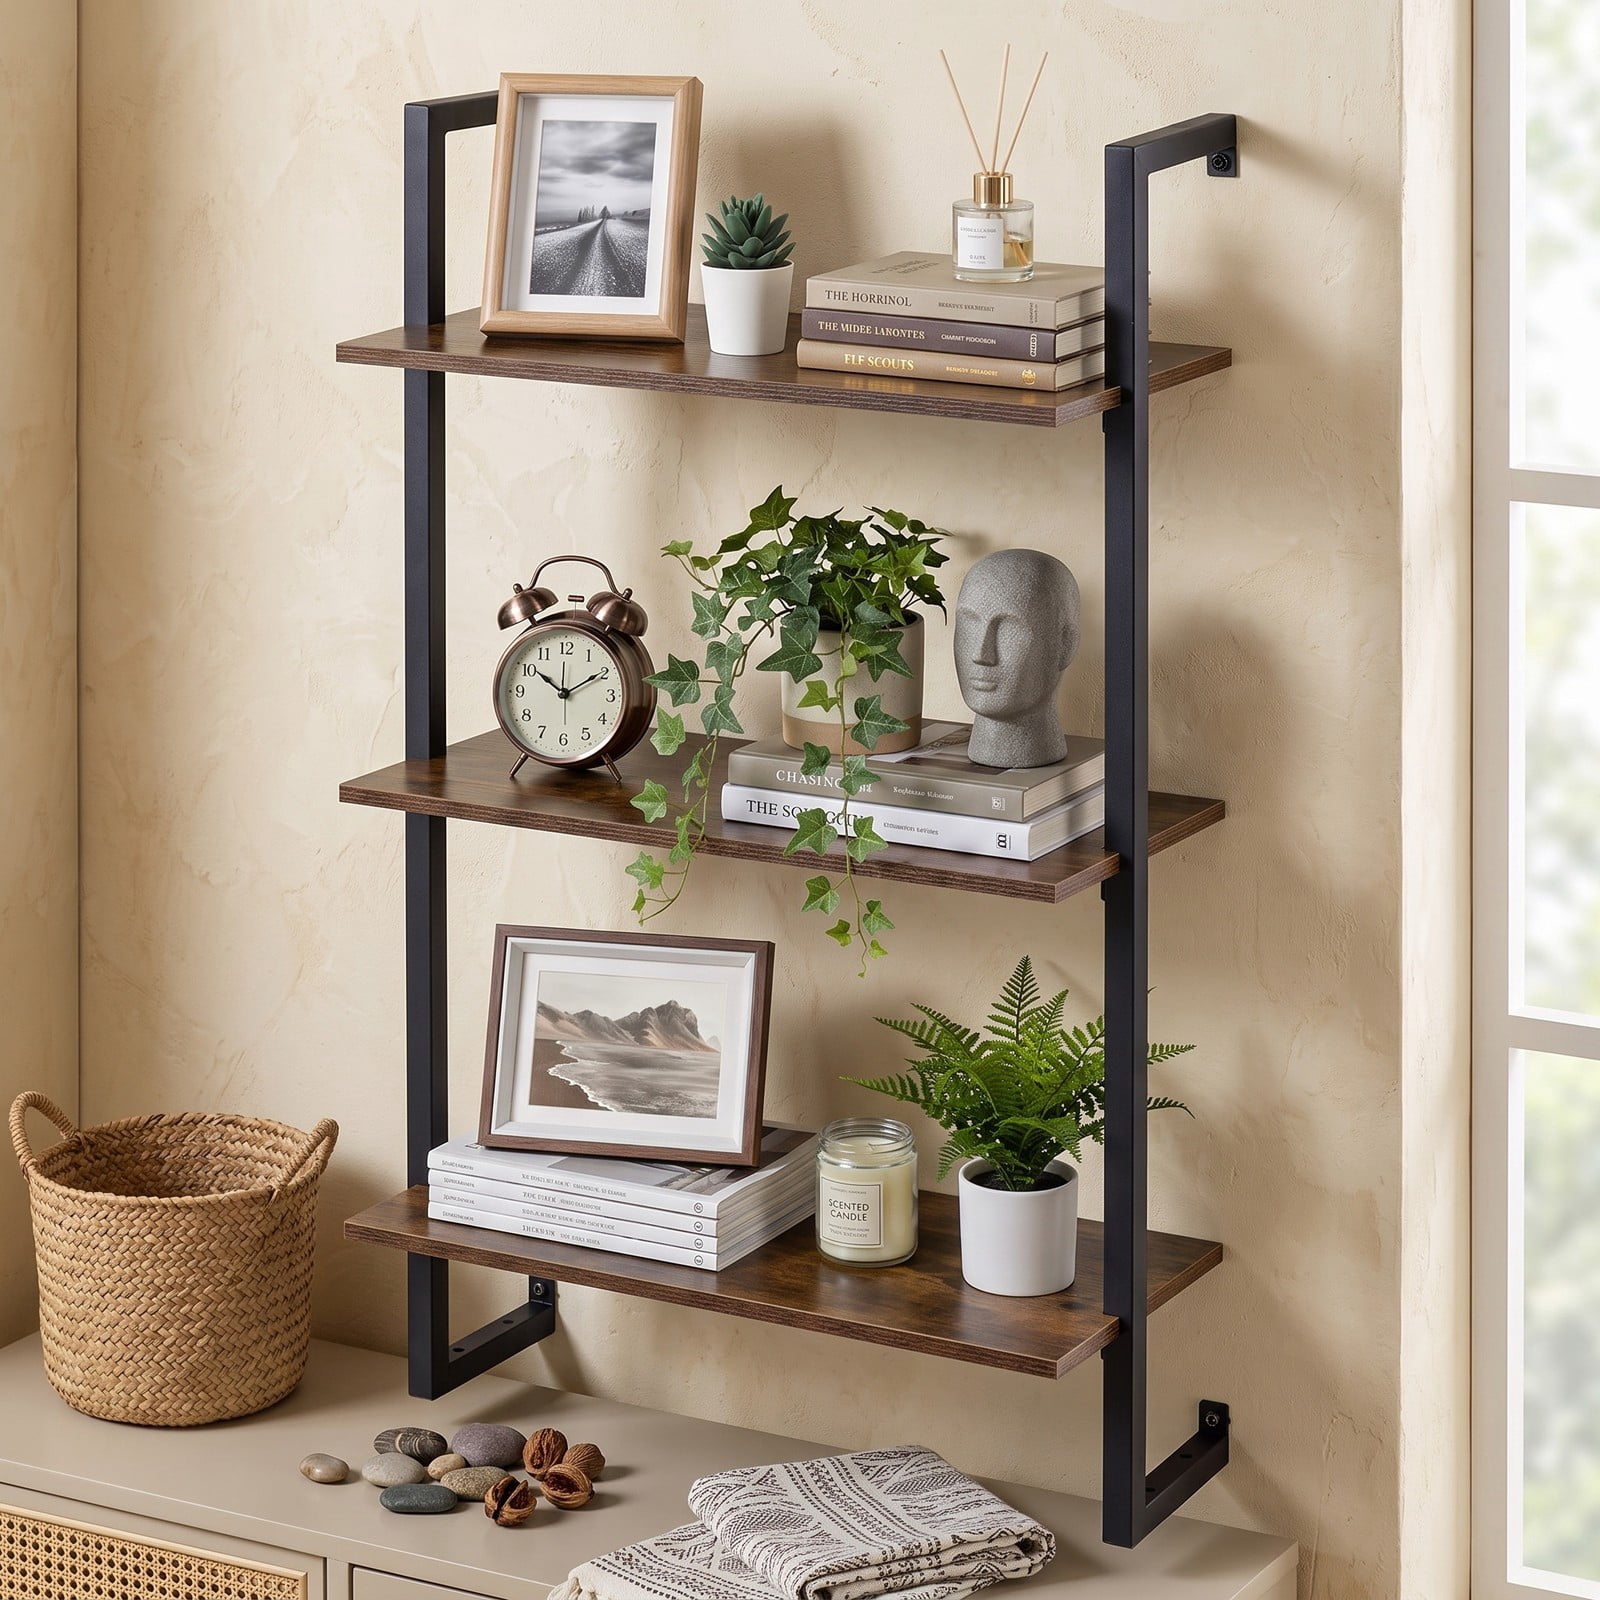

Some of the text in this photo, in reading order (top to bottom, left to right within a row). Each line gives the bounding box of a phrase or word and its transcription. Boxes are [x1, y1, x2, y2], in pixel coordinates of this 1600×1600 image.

[825, 290, 912, 307] THE HORRINOL
[818, 321, 839, 331] THE
[844, 353, 914, 371] ELF SCOUTS
[538, 647, 550, 661] 11
[560, 641, 574, 656] 12
[586, 649, 591, 662] 1
[522, 663, 537, 677] 10
[600, 667, 609, 680] 2
[515, 685, 525, 698] 9
[605, 689, 616, 702] 3
[521, 708, 531, 722] 8
[597, 712, 607, 725] 4
[538, 725, 546, 739] 7
[581, 727, 591, 741] 5
[558, 733, 568, 746] 6
[746, 800, 778, 816] THE
[828, 1198, 870, 1212] SCENTED
[830, 1209, 868, 1222] CANDLE
